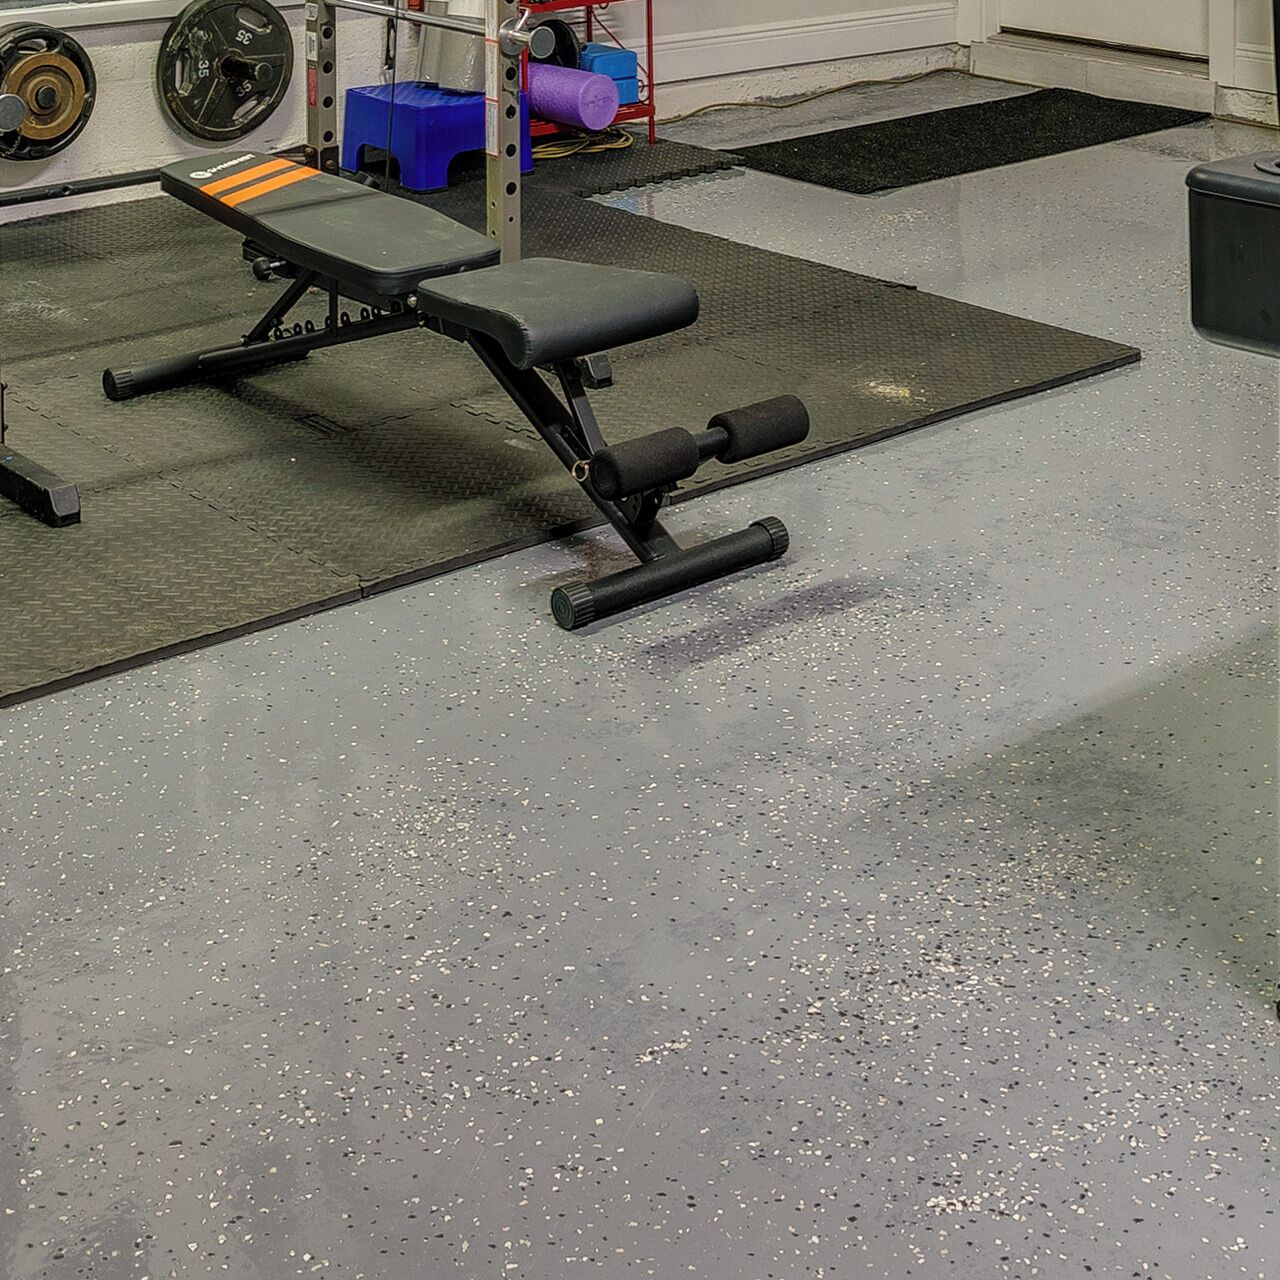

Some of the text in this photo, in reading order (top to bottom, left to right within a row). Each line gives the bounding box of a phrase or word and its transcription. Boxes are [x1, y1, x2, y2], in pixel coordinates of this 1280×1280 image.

[235, 29, 253, 45] 35
[198, 59, 210, 78] 35
[234, 80, 252, 97] 35
